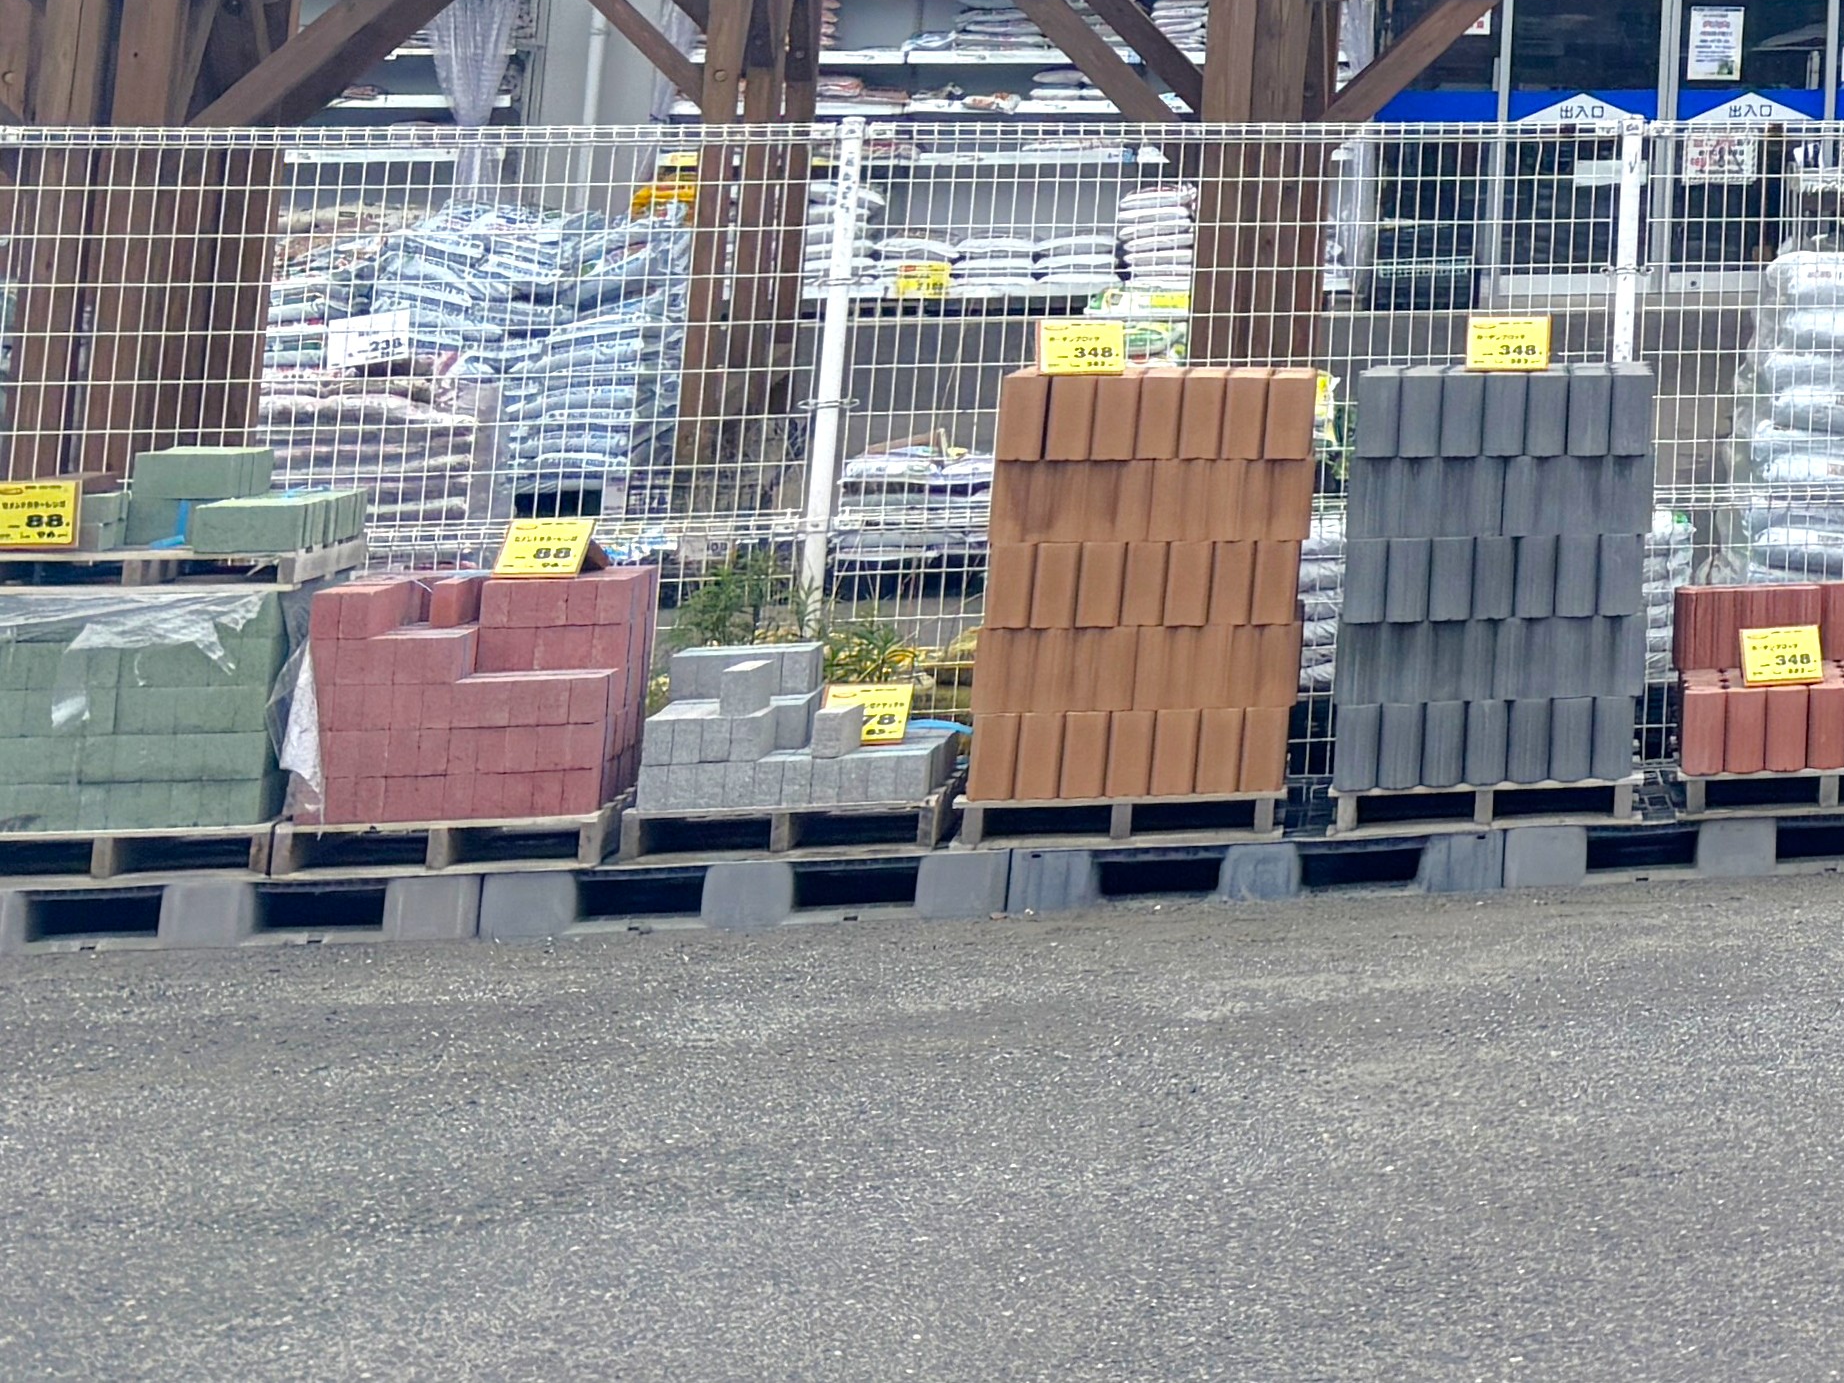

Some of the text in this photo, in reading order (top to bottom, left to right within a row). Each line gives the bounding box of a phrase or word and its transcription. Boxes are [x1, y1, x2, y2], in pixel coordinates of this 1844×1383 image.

[1559, 105, 1605, 119] 出入口
[1728, 104, 1773, 118] 出入口
[1073, 346, 1114, 359] 348
[1498, 344, 1537, 356] 348
[25, 513, 64, 528] 88
[532, 547, 572, 559] 88
[1774, 653, 1812, 666] 348
